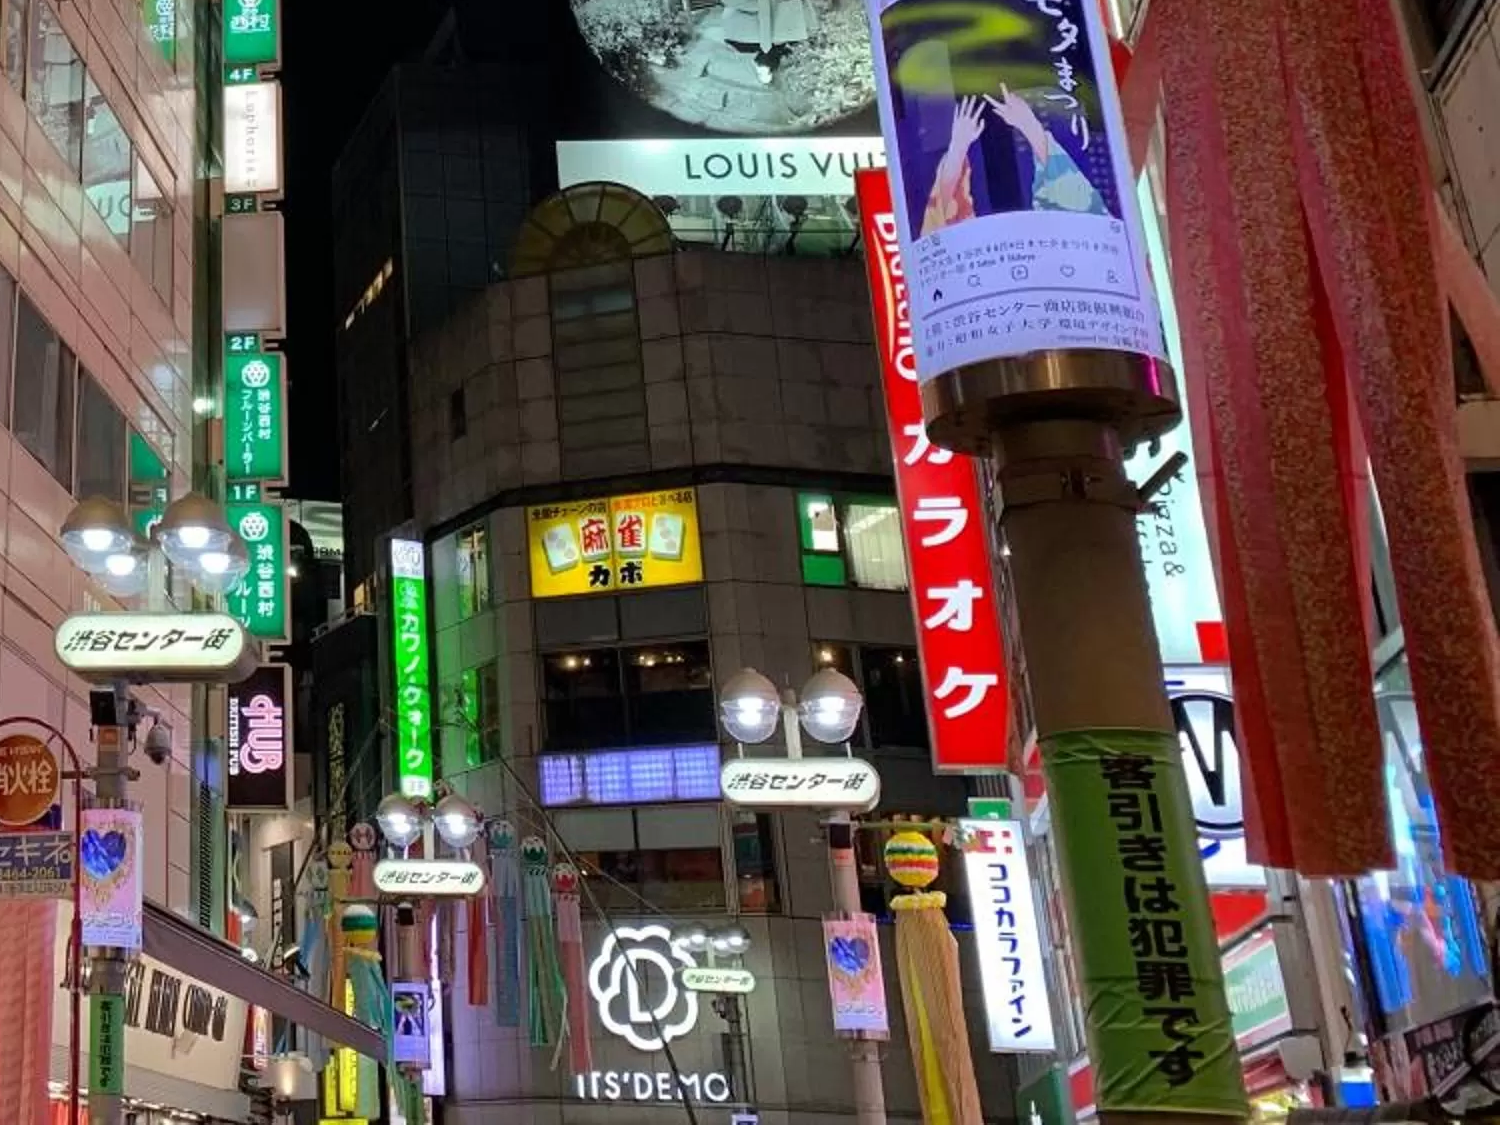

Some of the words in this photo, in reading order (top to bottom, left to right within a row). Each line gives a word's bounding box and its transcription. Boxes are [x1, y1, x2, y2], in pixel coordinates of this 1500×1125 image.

[230, 69, 253, 81] 4F
[685, 154, 797, 180] LOUIS
[231, 198, 254, 211] 3F
[231, 336, 256, 350] 2F
[234, 484, 258, 500] 1F
[580, 514, 644, 554] 麻雀
[256, 544, 275, 617] 渋谷西村
[588, 560, 643, 587] カボ
[902, 418, 999, 720] カラオケ
[64, 628, 235, 652] 渋谷センター街
[240, 694, 283, 774] HUB
[727, 773, 868, 791] 渋谷センター街
[379, 870, 479, 885] 渋谷センター街
[1101, 751, 1205, 1088] 客引きは犯罪です
[987, 862, 1032, 1038] ココカラファイン
